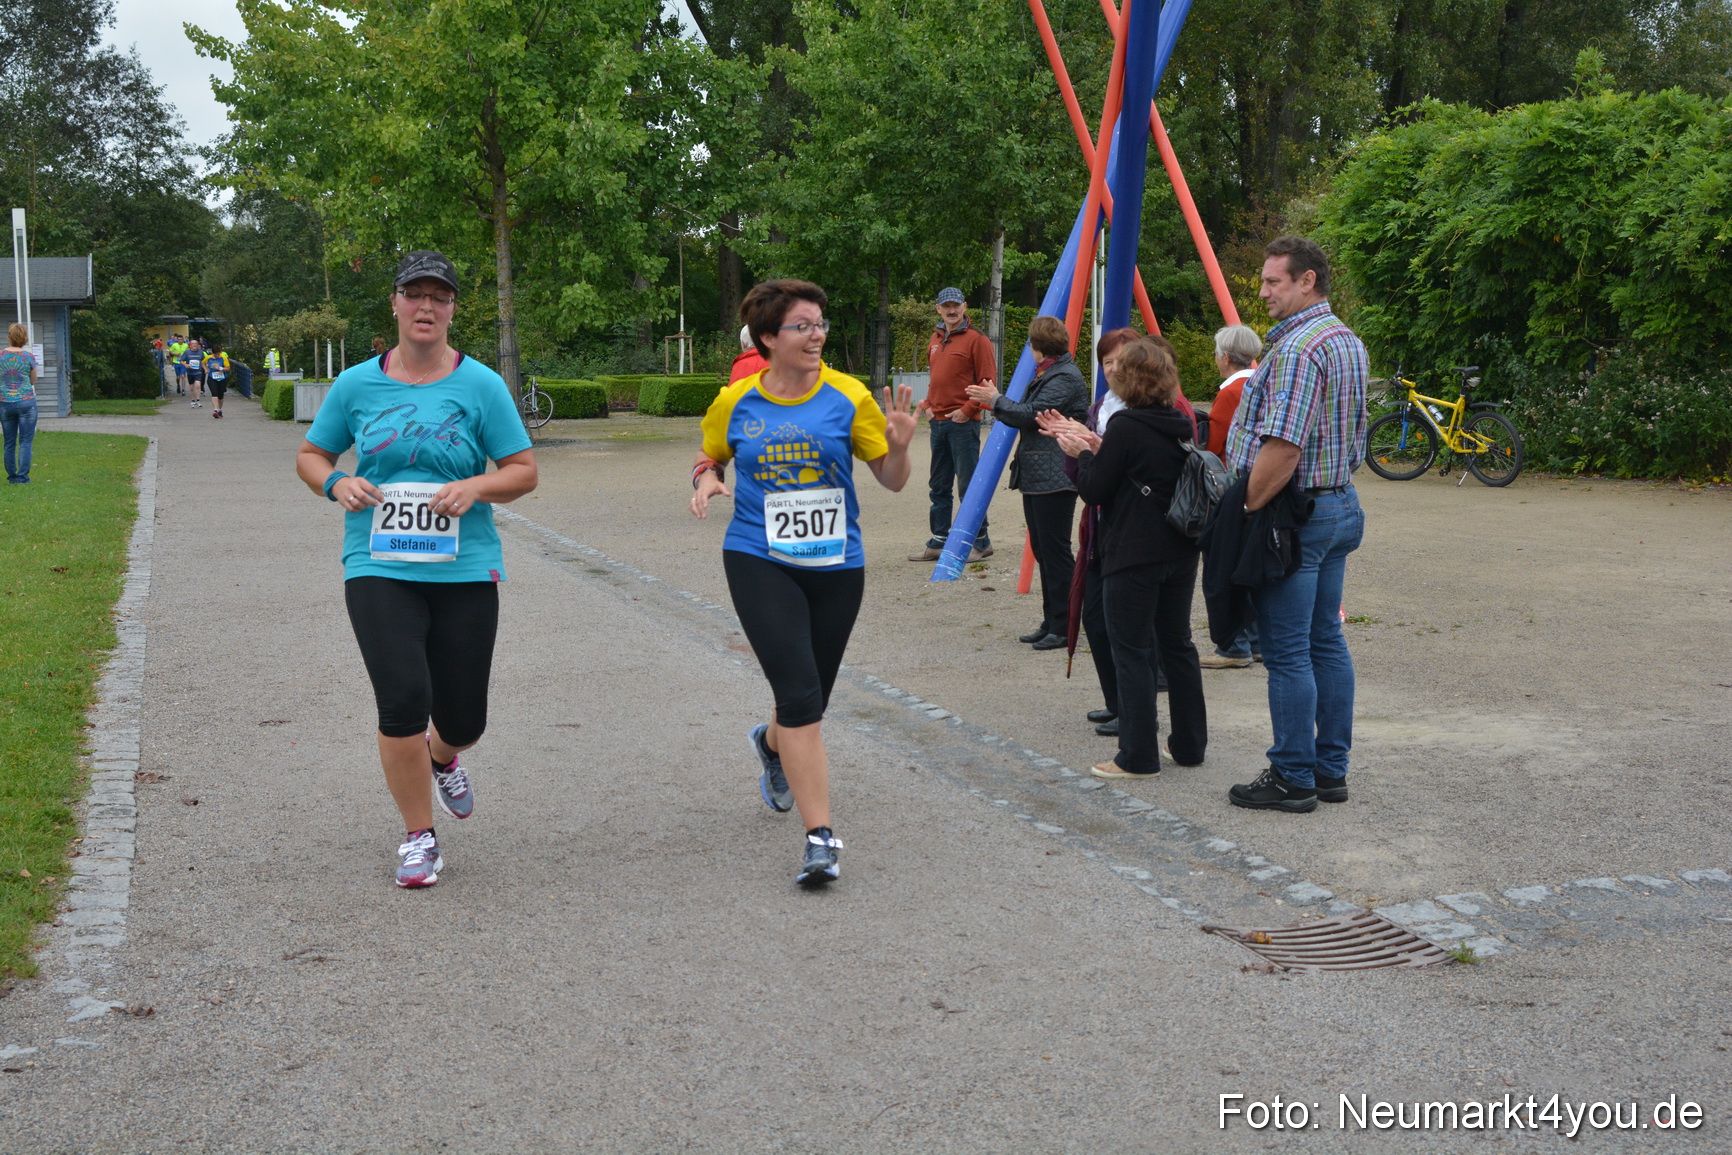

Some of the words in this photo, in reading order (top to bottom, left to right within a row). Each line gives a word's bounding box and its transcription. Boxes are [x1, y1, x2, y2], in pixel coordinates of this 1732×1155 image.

[766, 500, 794, 509] PARTL
[795, 497, 832, 507] Neumarkt
[381, 502, 451, 532] 2508
[775, 508, 838, 539] 2507
[390, 538, 437, 551] Stefanie
[792, 545, 827, 556] Sandra
